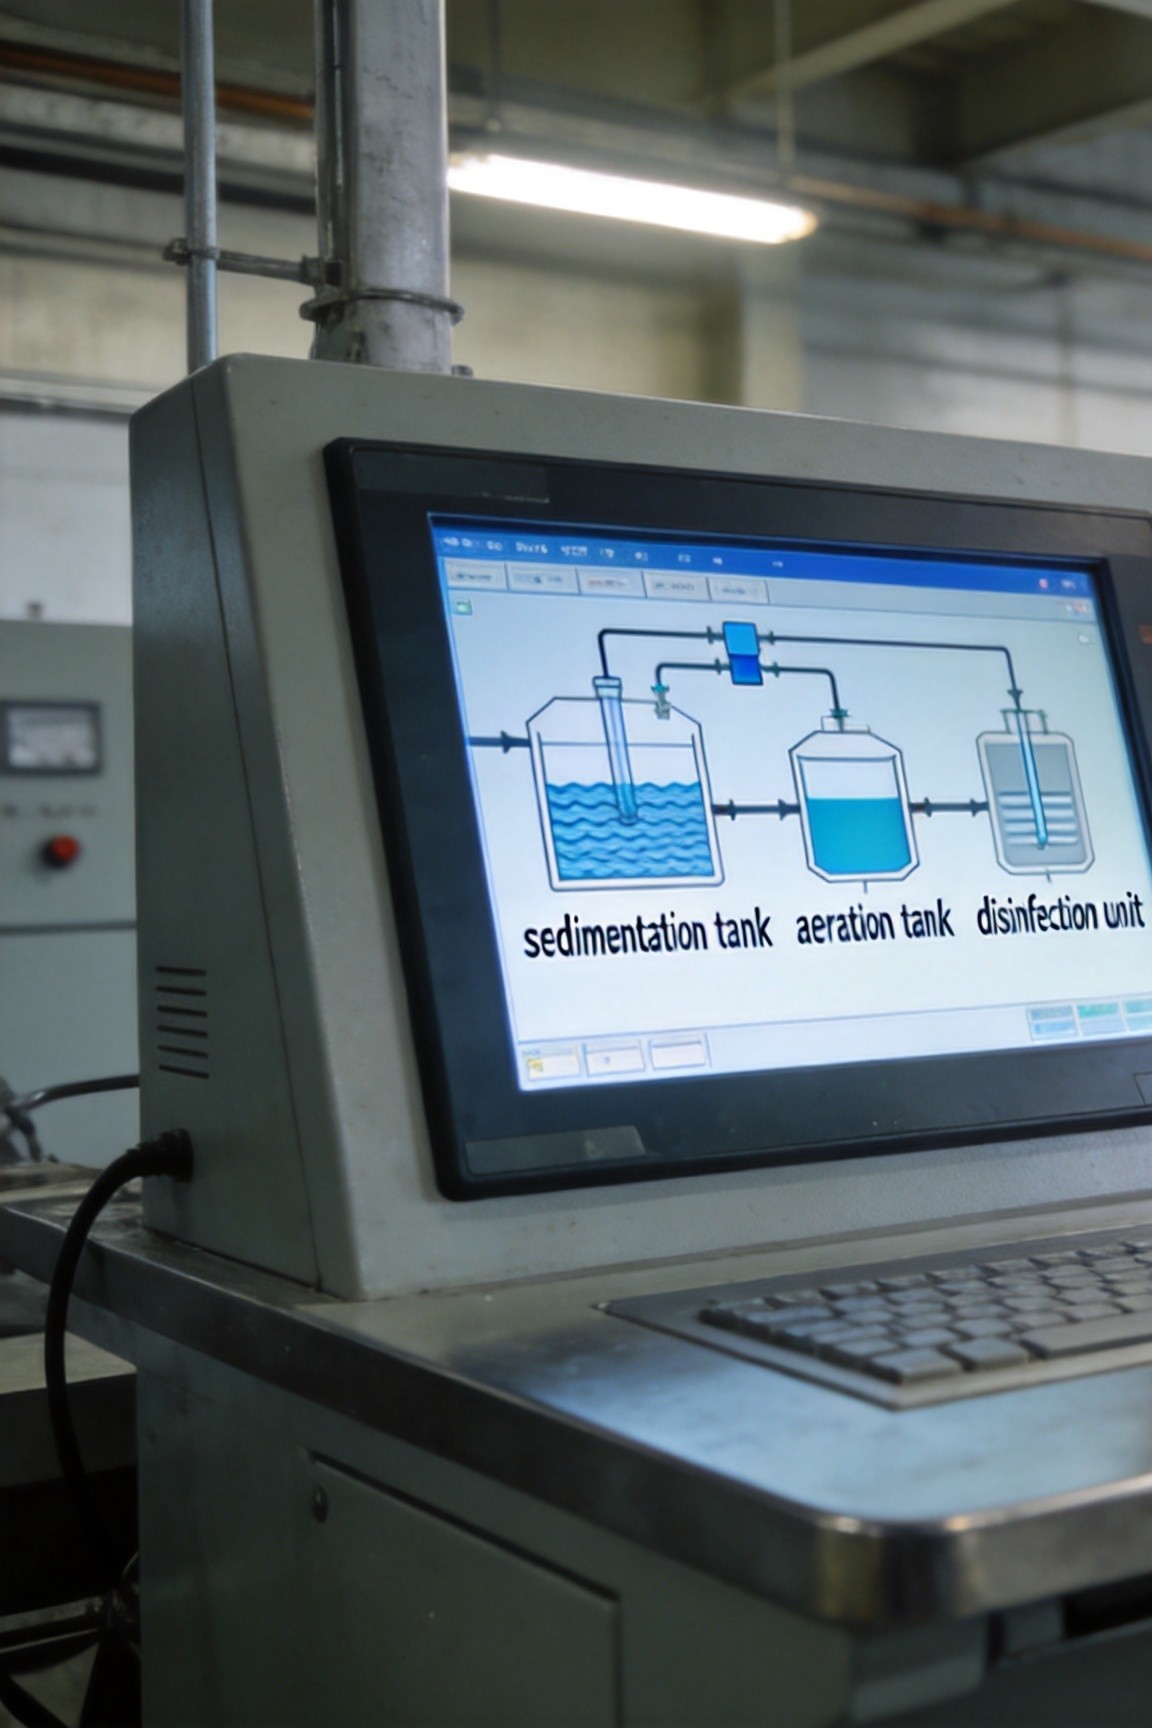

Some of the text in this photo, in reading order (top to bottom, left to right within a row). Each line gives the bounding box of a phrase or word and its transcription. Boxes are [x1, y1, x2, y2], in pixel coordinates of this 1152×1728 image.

[523, 906, 773, 958] sedimentation tank
[796, 898, 955, 944] aeration tank
[977, 891, 1146, 935] disinfection unit
